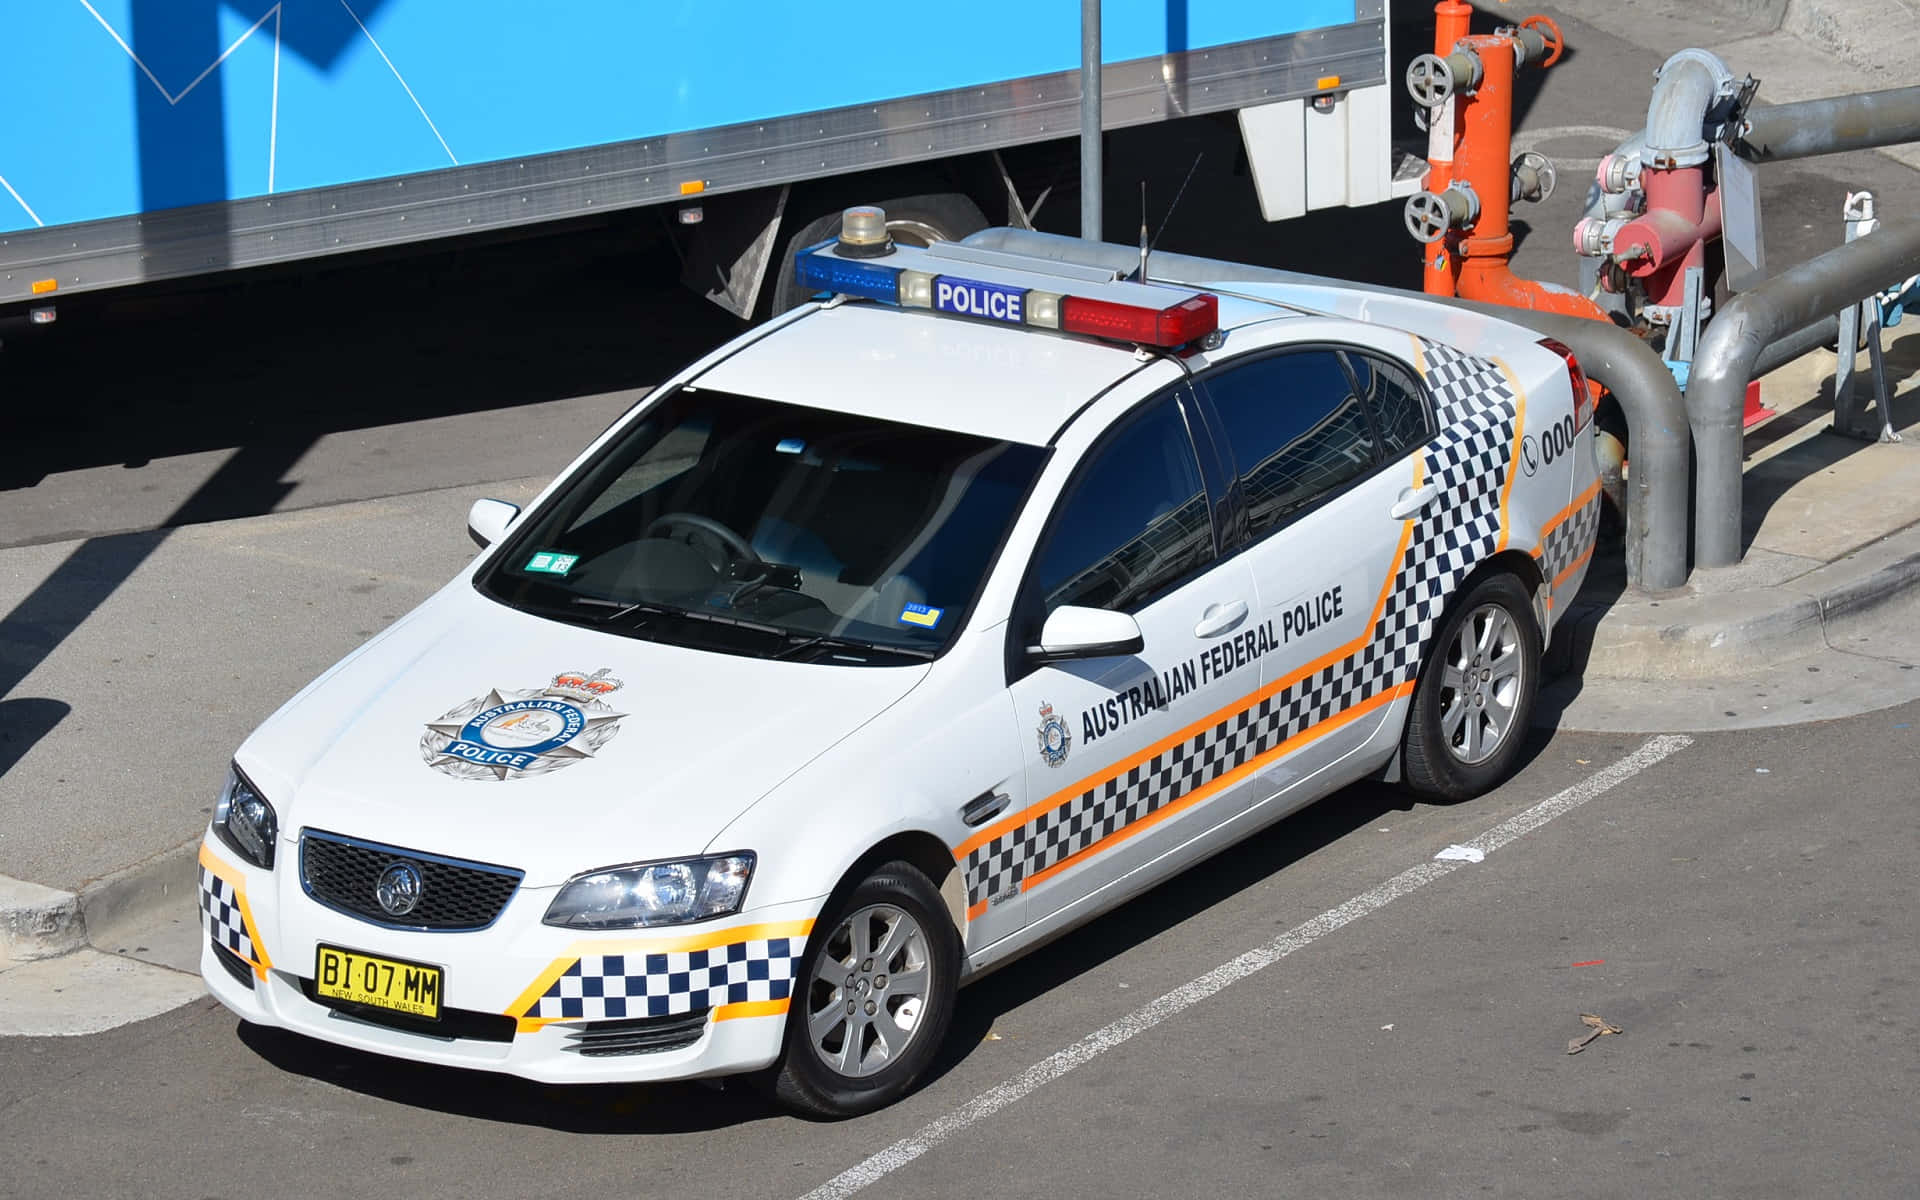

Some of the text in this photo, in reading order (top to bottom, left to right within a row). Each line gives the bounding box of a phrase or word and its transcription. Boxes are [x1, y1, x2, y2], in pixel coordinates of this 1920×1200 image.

[937, 283, 1021, 321] POLICE
[1541, 414, 1575, 465] 000
[1081, 585, 1343, 745] AUSTRALIAN FEDERAL POLICE
[469, 701, 582, 743] AUSTRALIAN FEDERAL
[451, 743, 529, 767] POLICE
[331, 989, 425, 1014] NEW SOUTH WALES
[364, 961, 395, 997] 07
[404, 968, 437, 1005] MM
